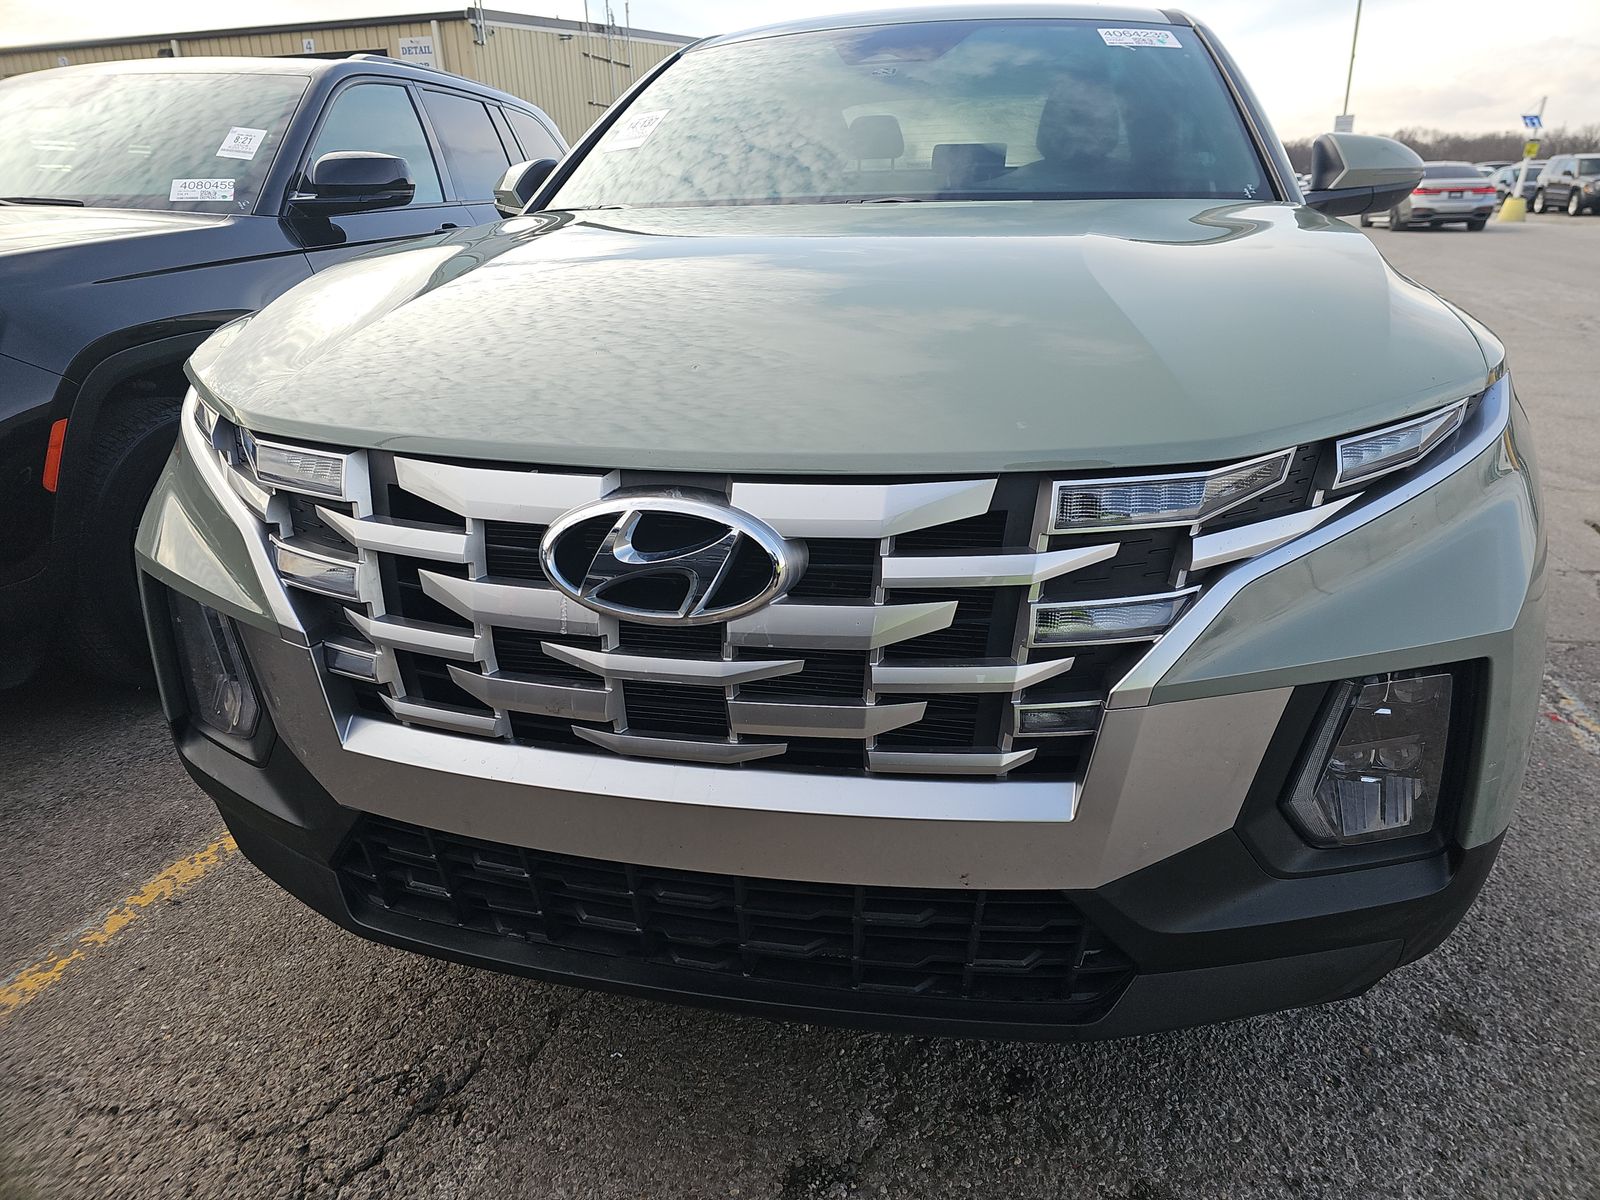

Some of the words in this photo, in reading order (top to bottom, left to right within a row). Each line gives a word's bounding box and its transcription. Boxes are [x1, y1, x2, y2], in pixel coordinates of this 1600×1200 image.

[401, 45, 433, 55] DETAIL
[233, 136, 253, 145] 8:21
[180, 181, 235, 190] 4080459
